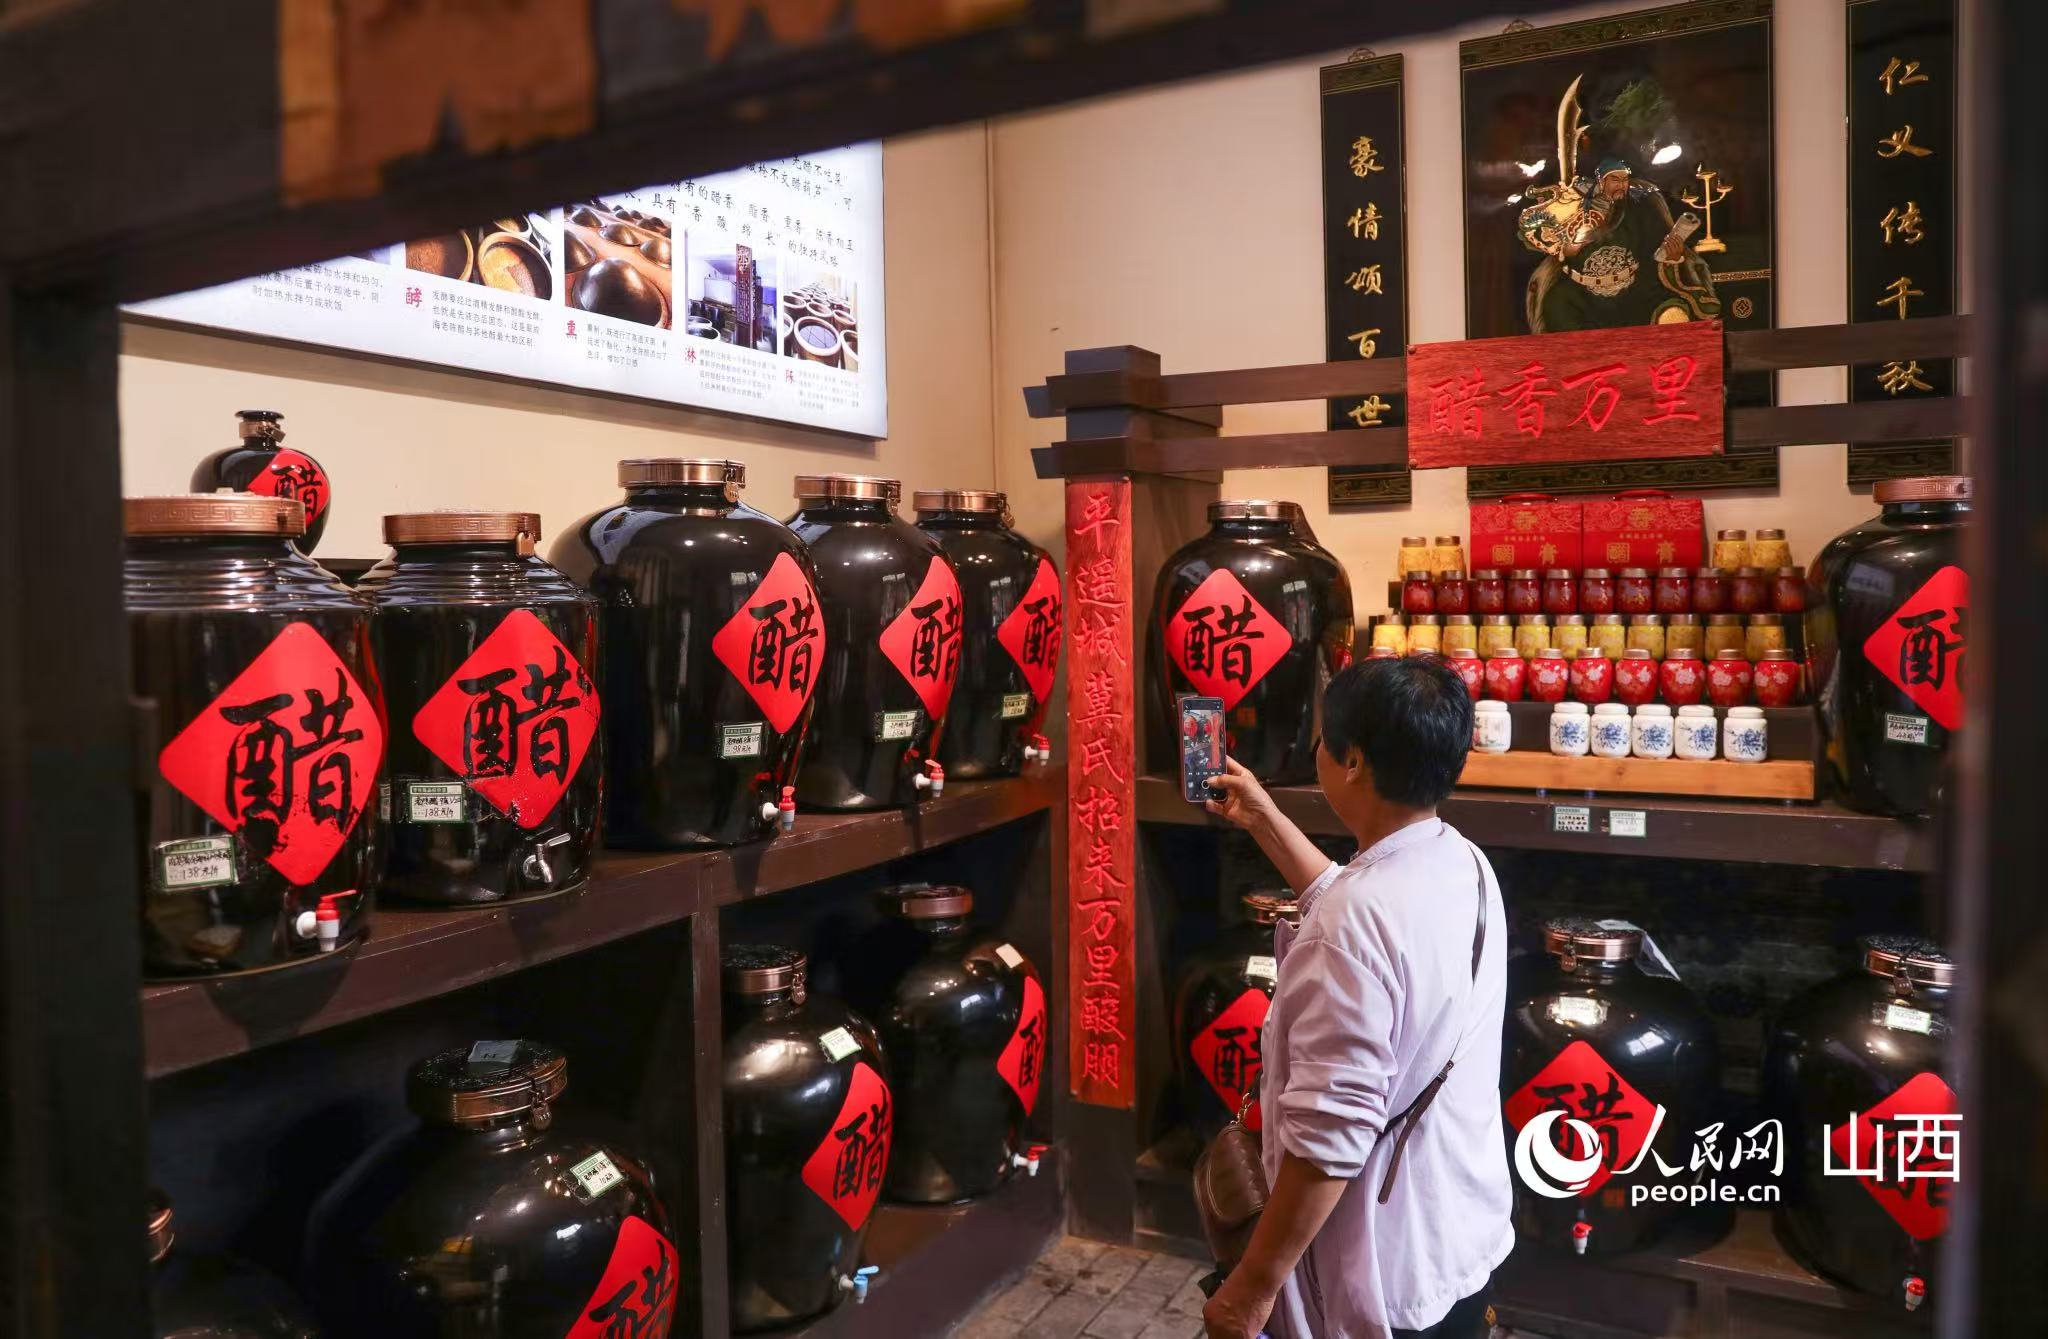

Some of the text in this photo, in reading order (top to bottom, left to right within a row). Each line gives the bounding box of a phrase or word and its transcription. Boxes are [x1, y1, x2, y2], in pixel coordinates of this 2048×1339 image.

[405, 287, 422, 308] 酵
[1428, 355, 1701, 440] 醋香万里
[271, 459, 322, 523] 醋
[748, 584, 818, 700] 醋
[911, 582, 963, 682] 醋
[1024, 596, 1062, 675] 醋
[1183, 594, 1264, 688] 醋
[220, 667, 363, 834] 醋
[458, 646, 580, 784] 醋
[833, 1085, 890, 1199] 醋
